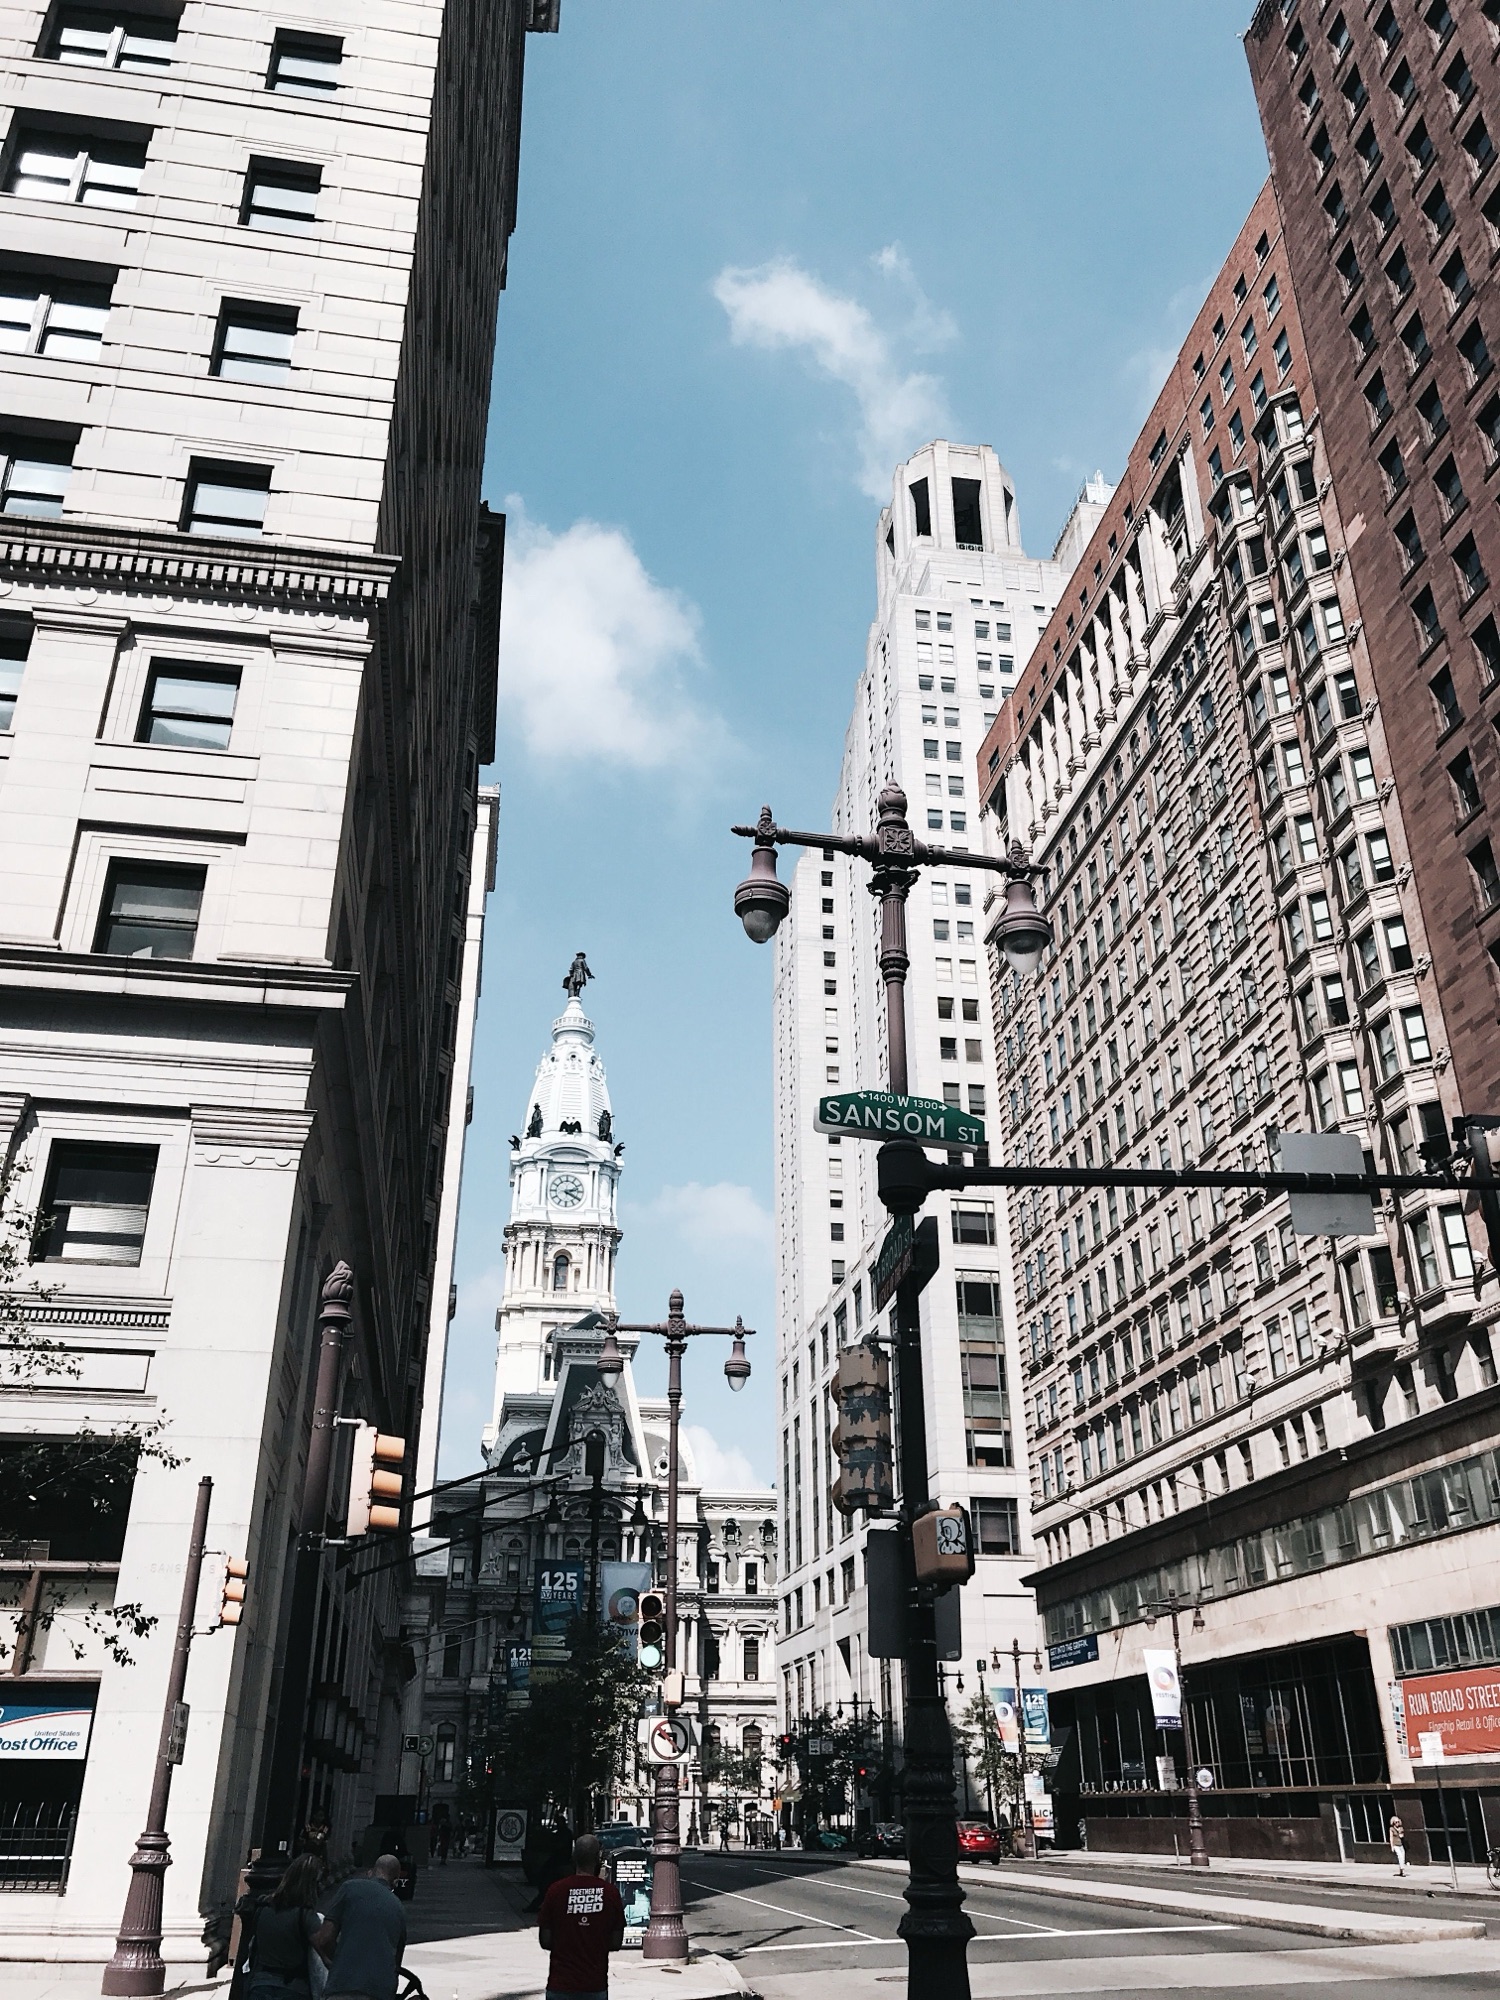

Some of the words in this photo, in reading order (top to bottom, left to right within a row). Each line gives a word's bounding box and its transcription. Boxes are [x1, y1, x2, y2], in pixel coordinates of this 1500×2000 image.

[868, 1092, 894, 1104] 1400
[897, 1096, 910, 1108] W
[913, 1099, 938, 1111] 1300
[825, 1100, 945, 1138] SANSOM
[957, 1126, 979, 1143] ST
[881, 1232, 903, 1283] BROAD
[541, 1571, 578, 1591] 125
[553, 1591, 577, 1600] YEARS
[1026, 1694, 1045, 1704] 125
[1408, 1692, 1430, 1717] RUN
[1430, 1687, 1465, 1714] BROAD
[1428, 1720, 1455, 1735] Flagship
[1456, 1718, 1475, 1731] Retail
[1475, 1717, 1483, 1729] &
[0, 1737, 28, 1751] ost
[29, 1737, 78, 1751] Office
[568, 1894, 604, 1904] ROCK
[569, 1888, 595, 1896] TOGETHER
[573, 1902, 603, 1914] RED
